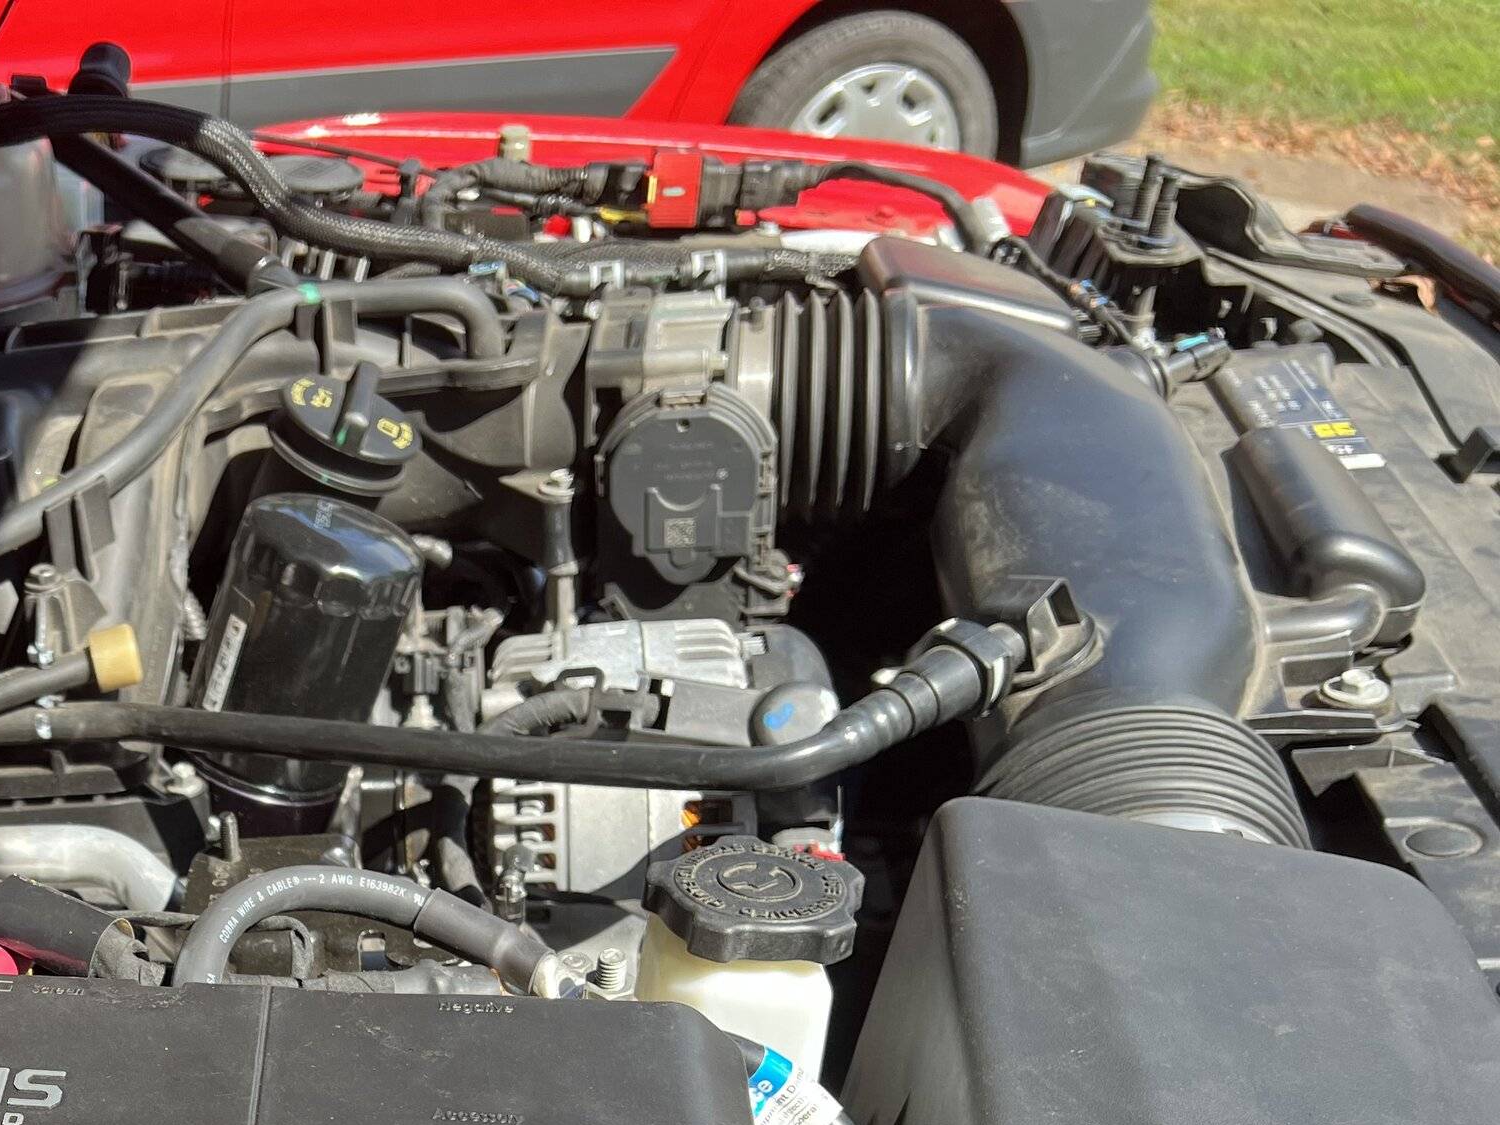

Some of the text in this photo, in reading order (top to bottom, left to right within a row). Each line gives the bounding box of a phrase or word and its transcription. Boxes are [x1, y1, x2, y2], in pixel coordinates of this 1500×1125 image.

[219, 916, 239, 944] COBRA
[237, 896, 256, 918] WIRE
[331, 873, 353, 885] AWG
